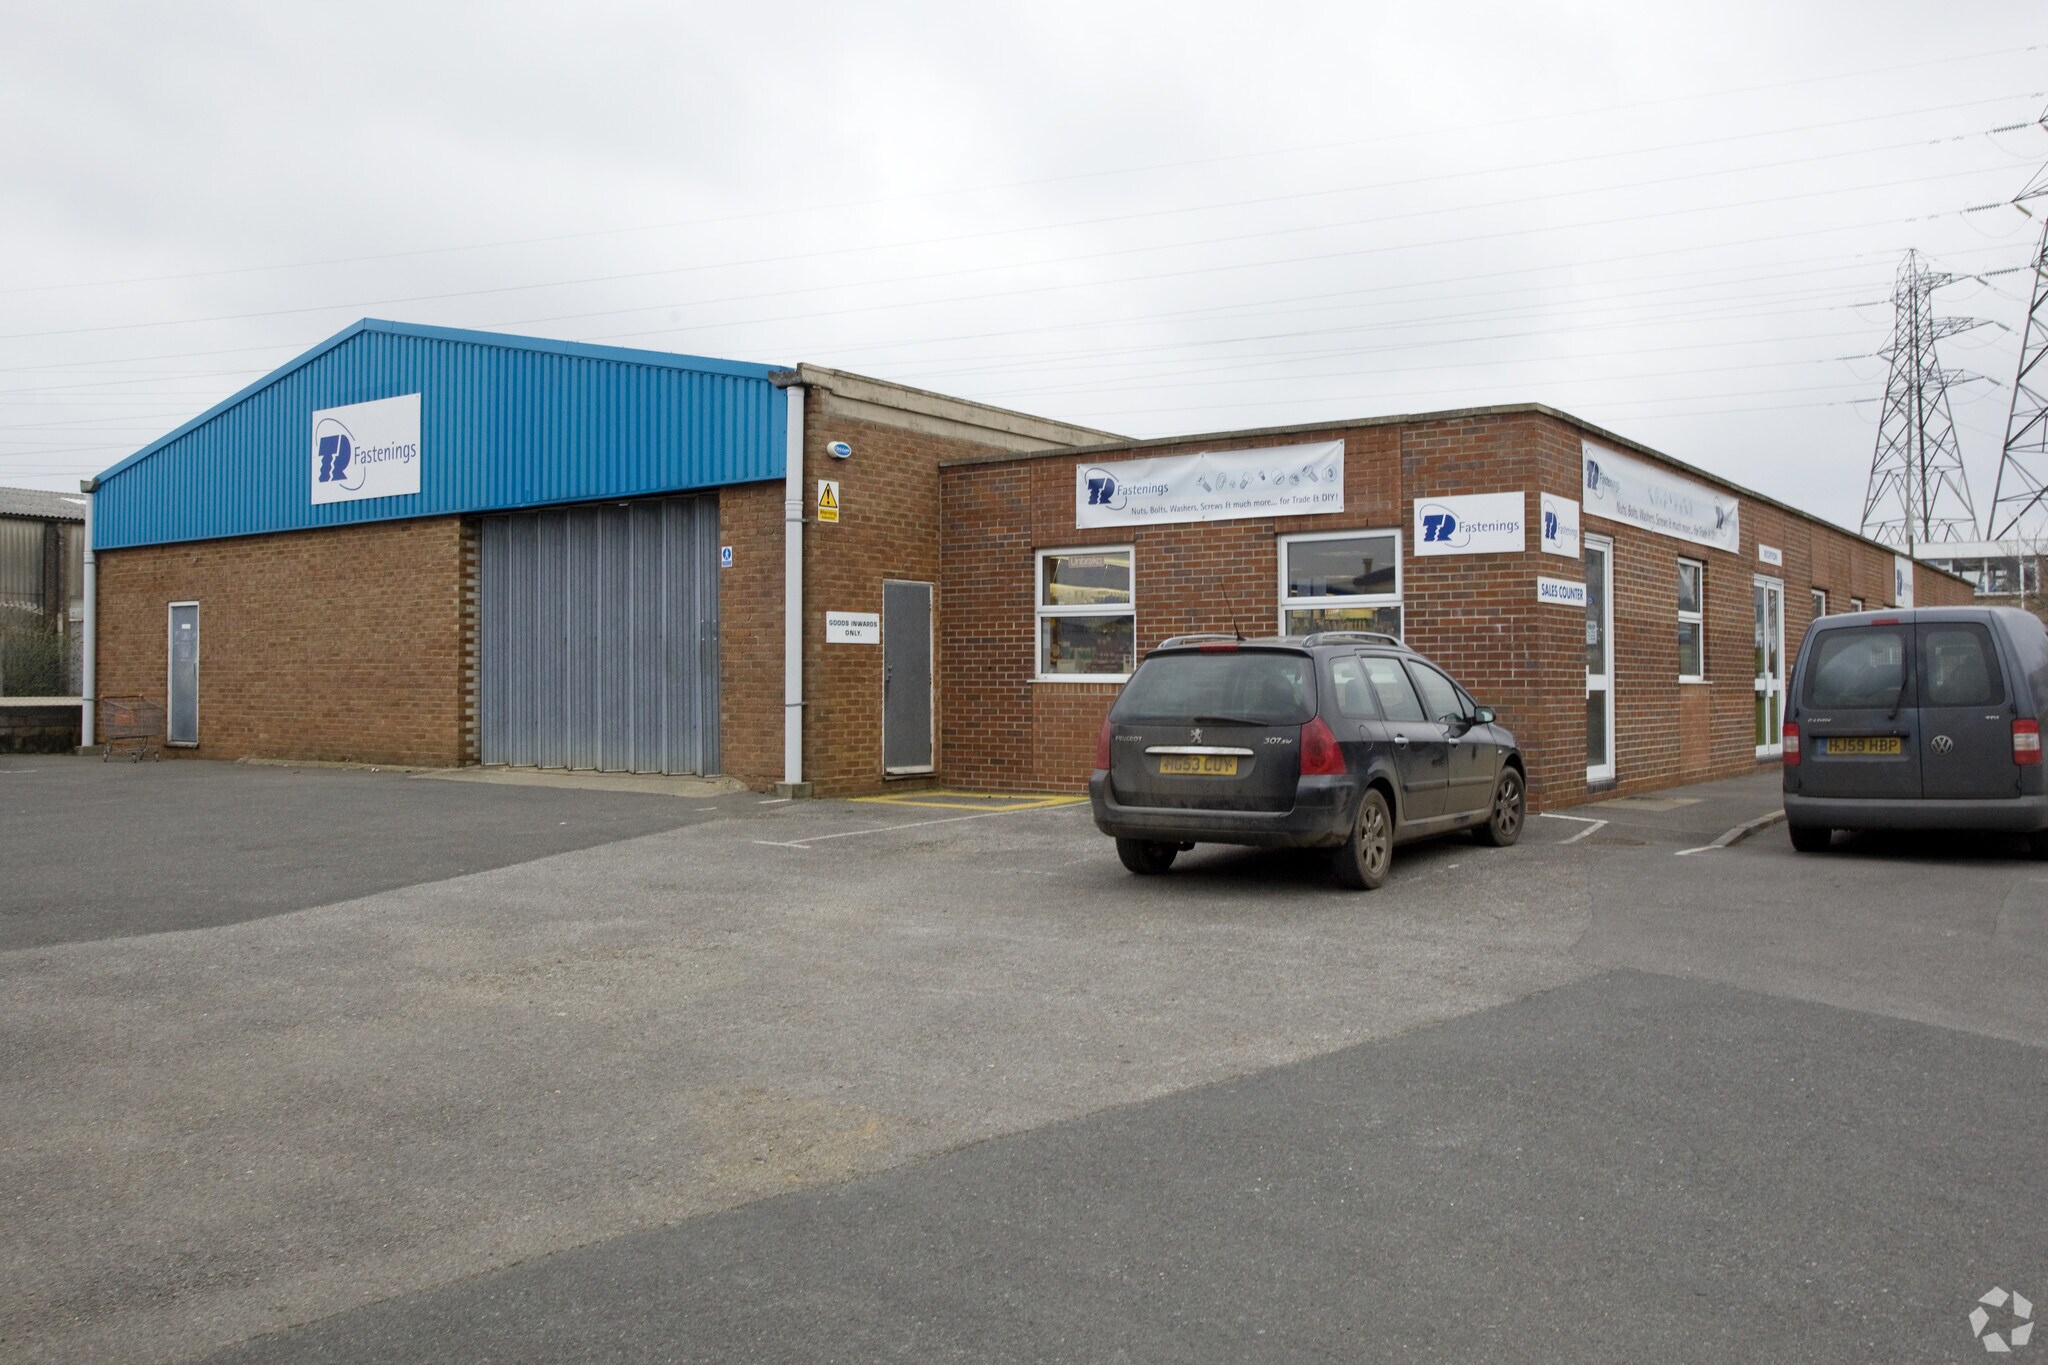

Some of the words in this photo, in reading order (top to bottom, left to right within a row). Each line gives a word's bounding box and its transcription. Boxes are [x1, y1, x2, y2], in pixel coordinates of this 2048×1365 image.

[318, 434, 351, 483] TR
[354, 441, 417, 465] Fastenings
[1087, 477, 1116, 505] TR
[1117, 482, 1169, 497] Fastenings
[1131, 506, 1149, 516] Nuts,
[1149, 505, 1168, 515] Bolts,
[1169, 503, 1198, 513] Washers,
[1200, 502, 1224, 511] Screws
[1233, 499, 1252, 509] much
[1279, 496, 1290, 505] for
[1292, 495, 1311, 504] Trade
[1321, 493, 1339, 502] DIY!
[1423, 514, 1456, 542] TR
[1459, 520, 1520, 534] Fastenings
[1558, 522, 1578, 541] Fastenings
[1541, 583, 1558, 598] SALES
[1559, 585, 1584, 600] COUNTER
[829, 619, 850, 627] GOODS
[850, 620, 878, 628] INWARDS
[1263, 736, 1281, 745] 307
[1829, 739, 1866, 752] HJ59
[1869, 739, 1898, 752] HBP
